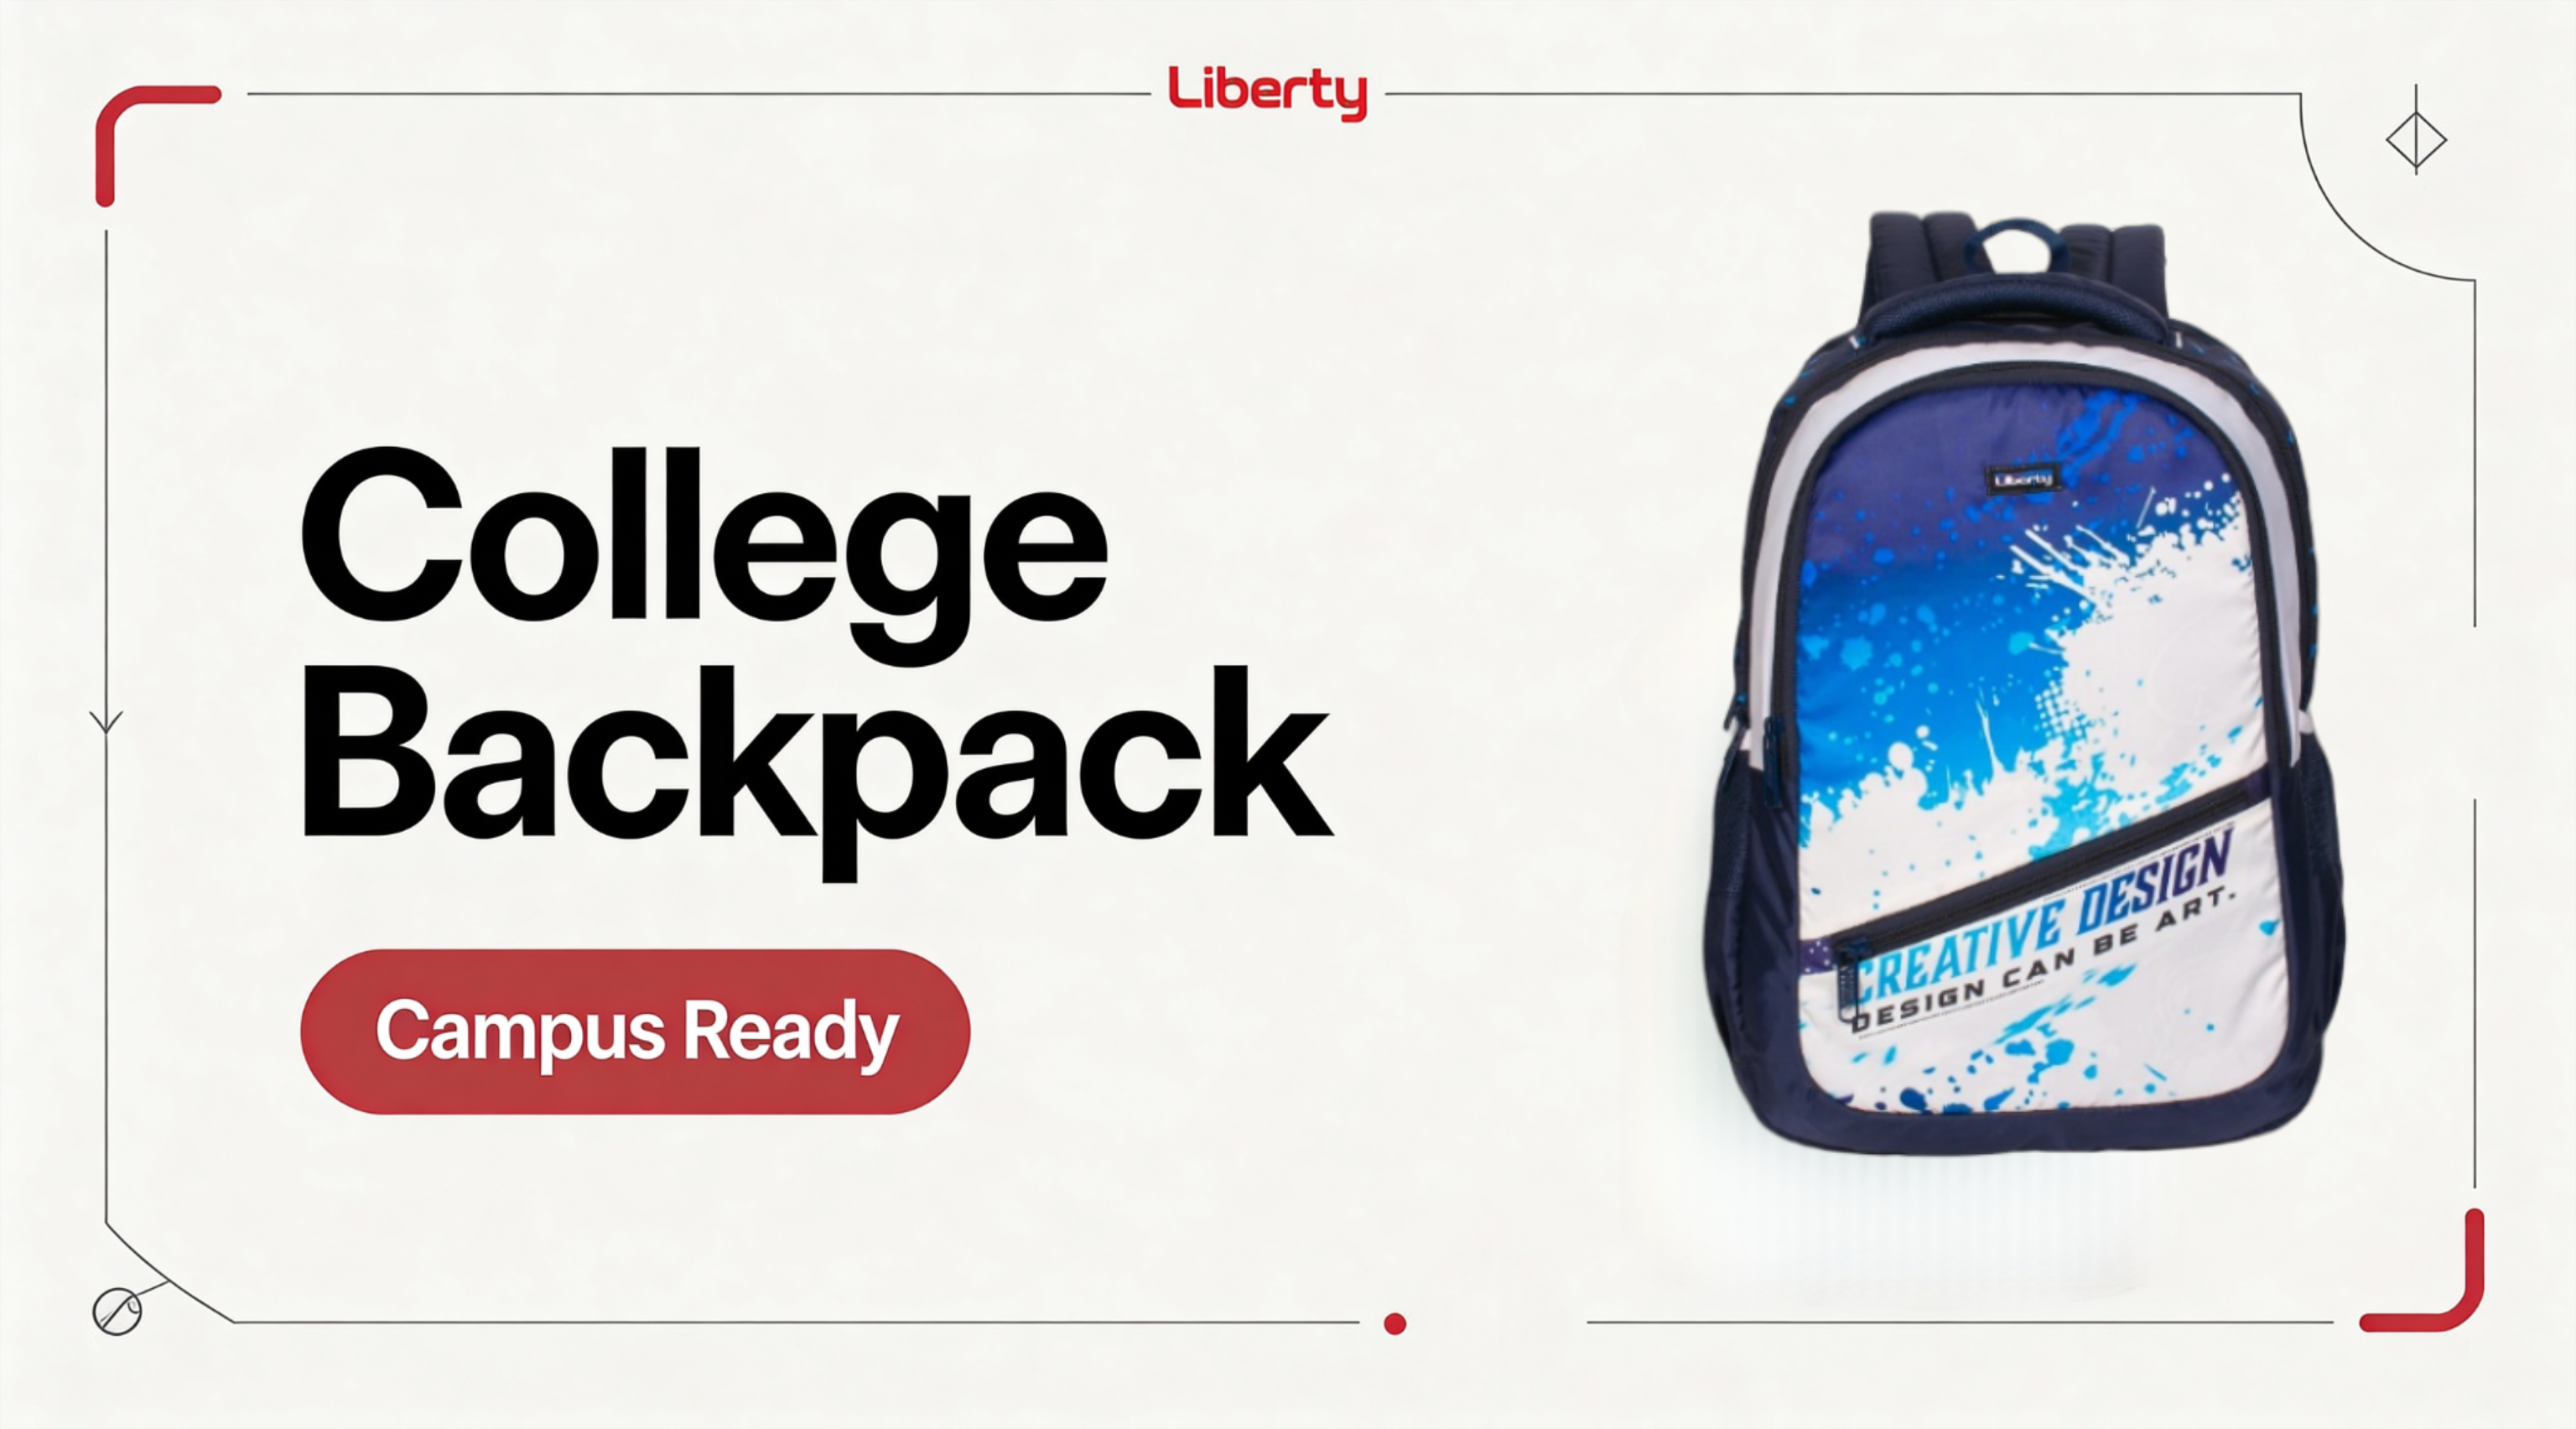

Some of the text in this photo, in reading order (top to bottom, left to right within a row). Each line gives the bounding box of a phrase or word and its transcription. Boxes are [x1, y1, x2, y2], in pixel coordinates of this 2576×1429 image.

[1168, 65, 1368, 123] Liberty
[302, 446, 1108, 667] College
[304, 666, 1335, 884] Backpack
[1852, 976, 1985, 1035] DESIGN
[2002, 947, 2076, 989] CAN
[2094, 924, 2138, 957] BE
[2155, 885, 2237, 933] ART.
[1853, 900, 2065, 1006] CREATIVE
[2076, 828, 2236, 937] DESIGN
[377, 998, 901, 1076] Campus Ready
